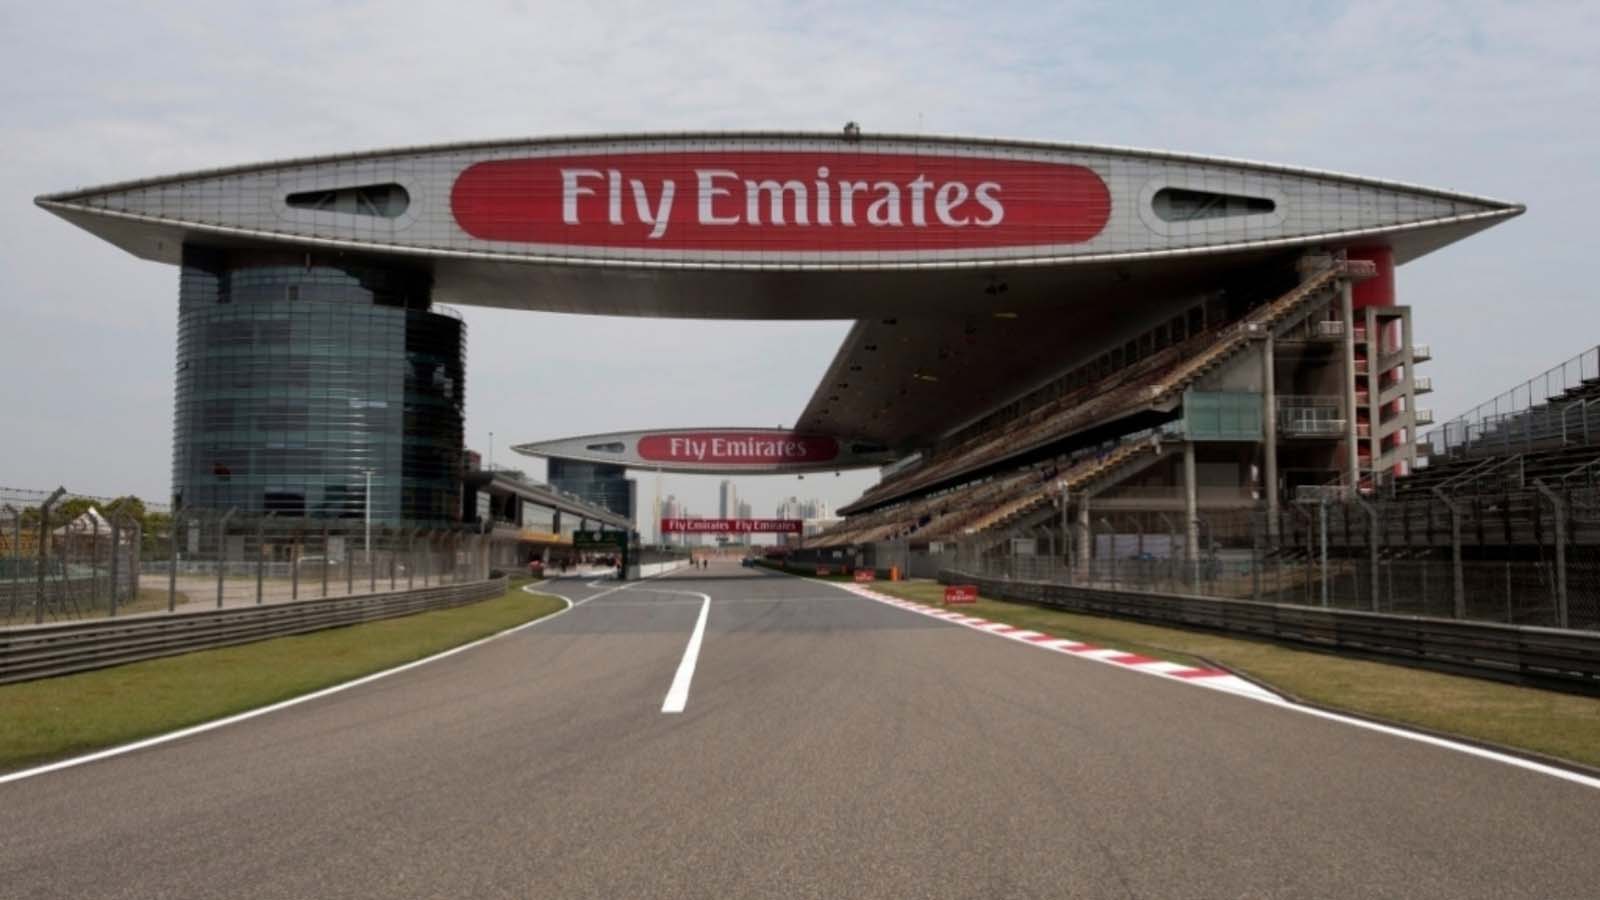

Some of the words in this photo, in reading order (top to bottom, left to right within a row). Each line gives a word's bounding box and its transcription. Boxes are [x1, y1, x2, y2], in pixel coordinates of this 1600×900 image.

[560, 168, 675, 239] Fly
[695, 166, 1006, 227] Emirates
[670, 437, 707, 460] Fly
[711, 437, 807, 457] Emirates
[669, 521, 686, 531] Fly
[687, 521, 730, 531] Emirates
[735, 521, 753, 532] Fly
[753, 521, 797, 531] Emirates
